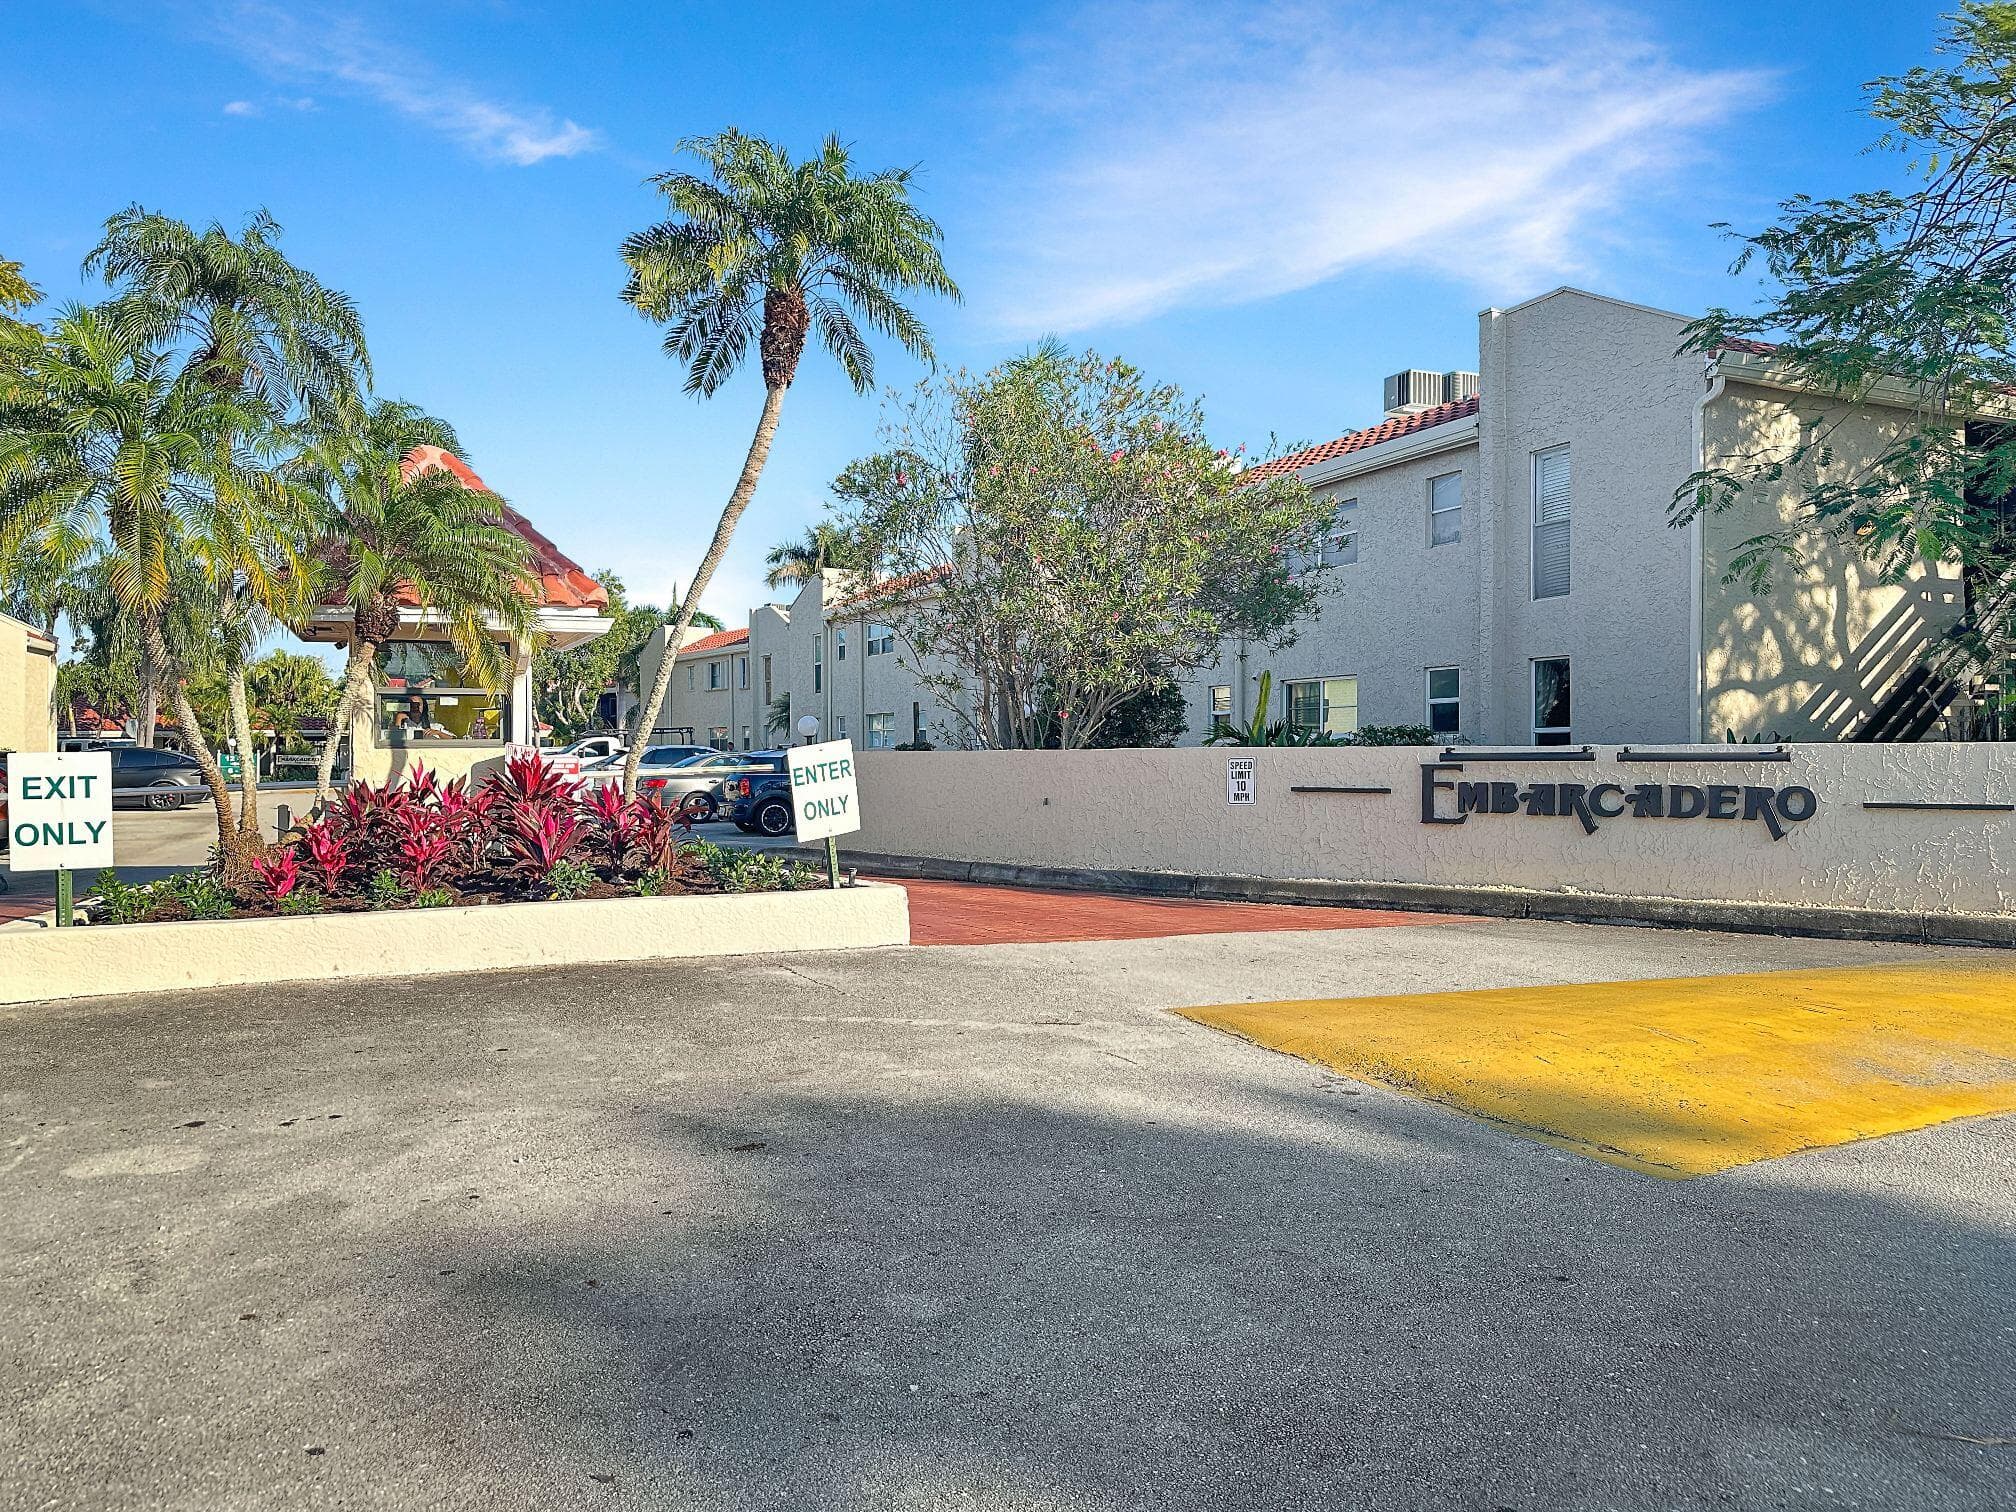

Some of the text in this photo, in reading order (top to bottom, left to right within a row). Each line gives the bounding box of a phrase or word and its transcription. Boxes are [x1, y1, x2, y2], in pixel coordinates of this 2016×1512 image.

[793, 759, 852, 787] ENTER
[1230, 761, 1253, 770] SPEED
[1231, 770, 1252, 780] LIMIT
[22, 775, 98, 800] EXIT
[1233, 792, 1250, 802] MPH
[1236, 780, 1247, 792] 10
[803, 794, 849, 821] ONLY
[1420, 763, 1817, 841] EMBARCADERO
[14, 820, 107, 847] ONLY
